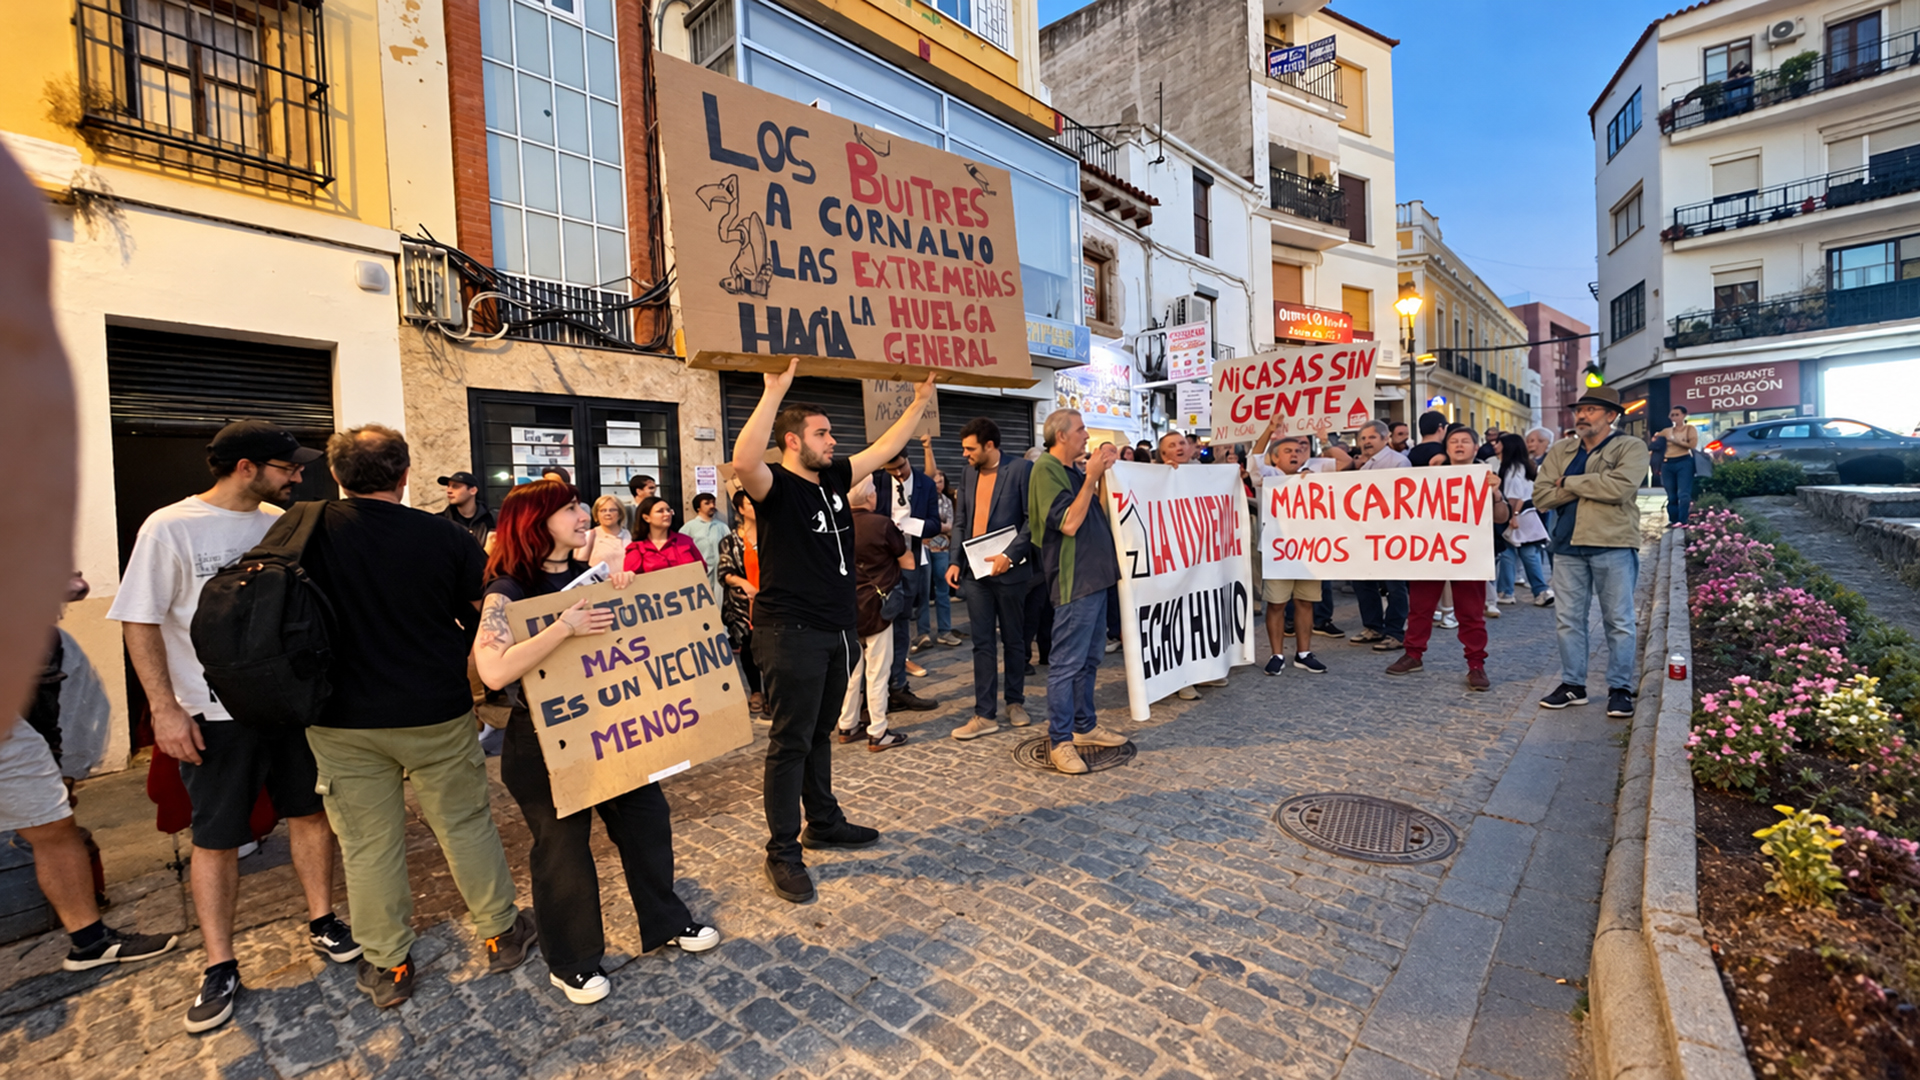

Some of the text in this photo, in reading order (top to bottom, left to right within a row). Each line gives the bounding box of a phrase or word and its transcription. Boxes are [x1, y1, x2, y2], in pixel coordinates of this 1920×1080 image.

[702, 91, 989, 229] LOS BUITRES
[766, 182, 994, 264] A CORNALVO
[770, 240, 1016, 298] LAS EXTREMEÑAS
[849, 295, 876, 326] LA
[888, 295, 996, 334] HUELGA
[883, 332, 998, 368] GENERAL
[1242, 353, 1324, 391] CASAS
[1686, 376, 1783, 400] EL DRAGÓN
[1695, 367, 1775, 386] RESTAURANTE
[1230, 384, 1346, 423] GENTE
[1711, 394, 1758, 410] ROJO
[1343, 470, 1491, 526] CARMEN
[1148, 500, 1176, 576] LA
[1272, 532, 1470, 564] SOMOS TODAS
[1136, 596, 1184, 680] ECHO
[598, 676, 641, 707] UN
[590, 698, 699, 760] MENOS
